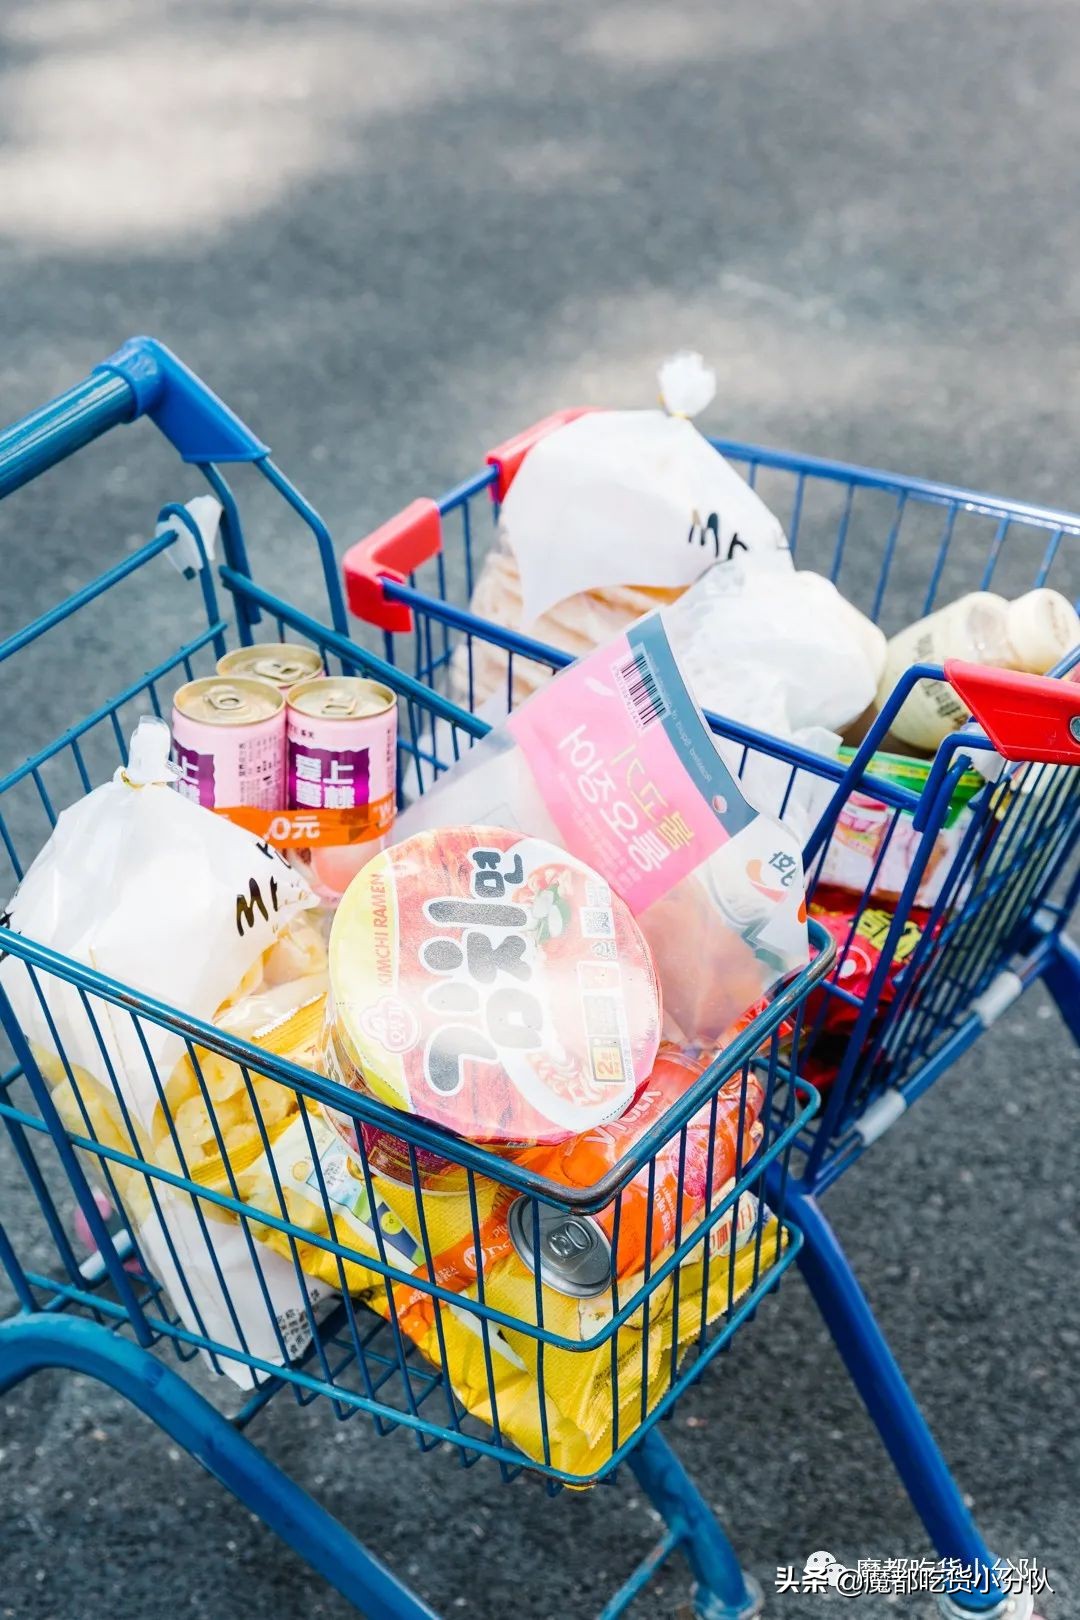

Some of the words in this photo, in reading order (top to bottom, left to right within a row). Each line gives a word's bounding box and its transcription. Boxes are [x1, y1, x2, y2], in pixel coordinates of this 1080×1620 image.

[373, 873, 388, 928] RAMEN
[376, 931, 393, 988] KIMCHI
[424, 850, 543, 1093] 김치면
